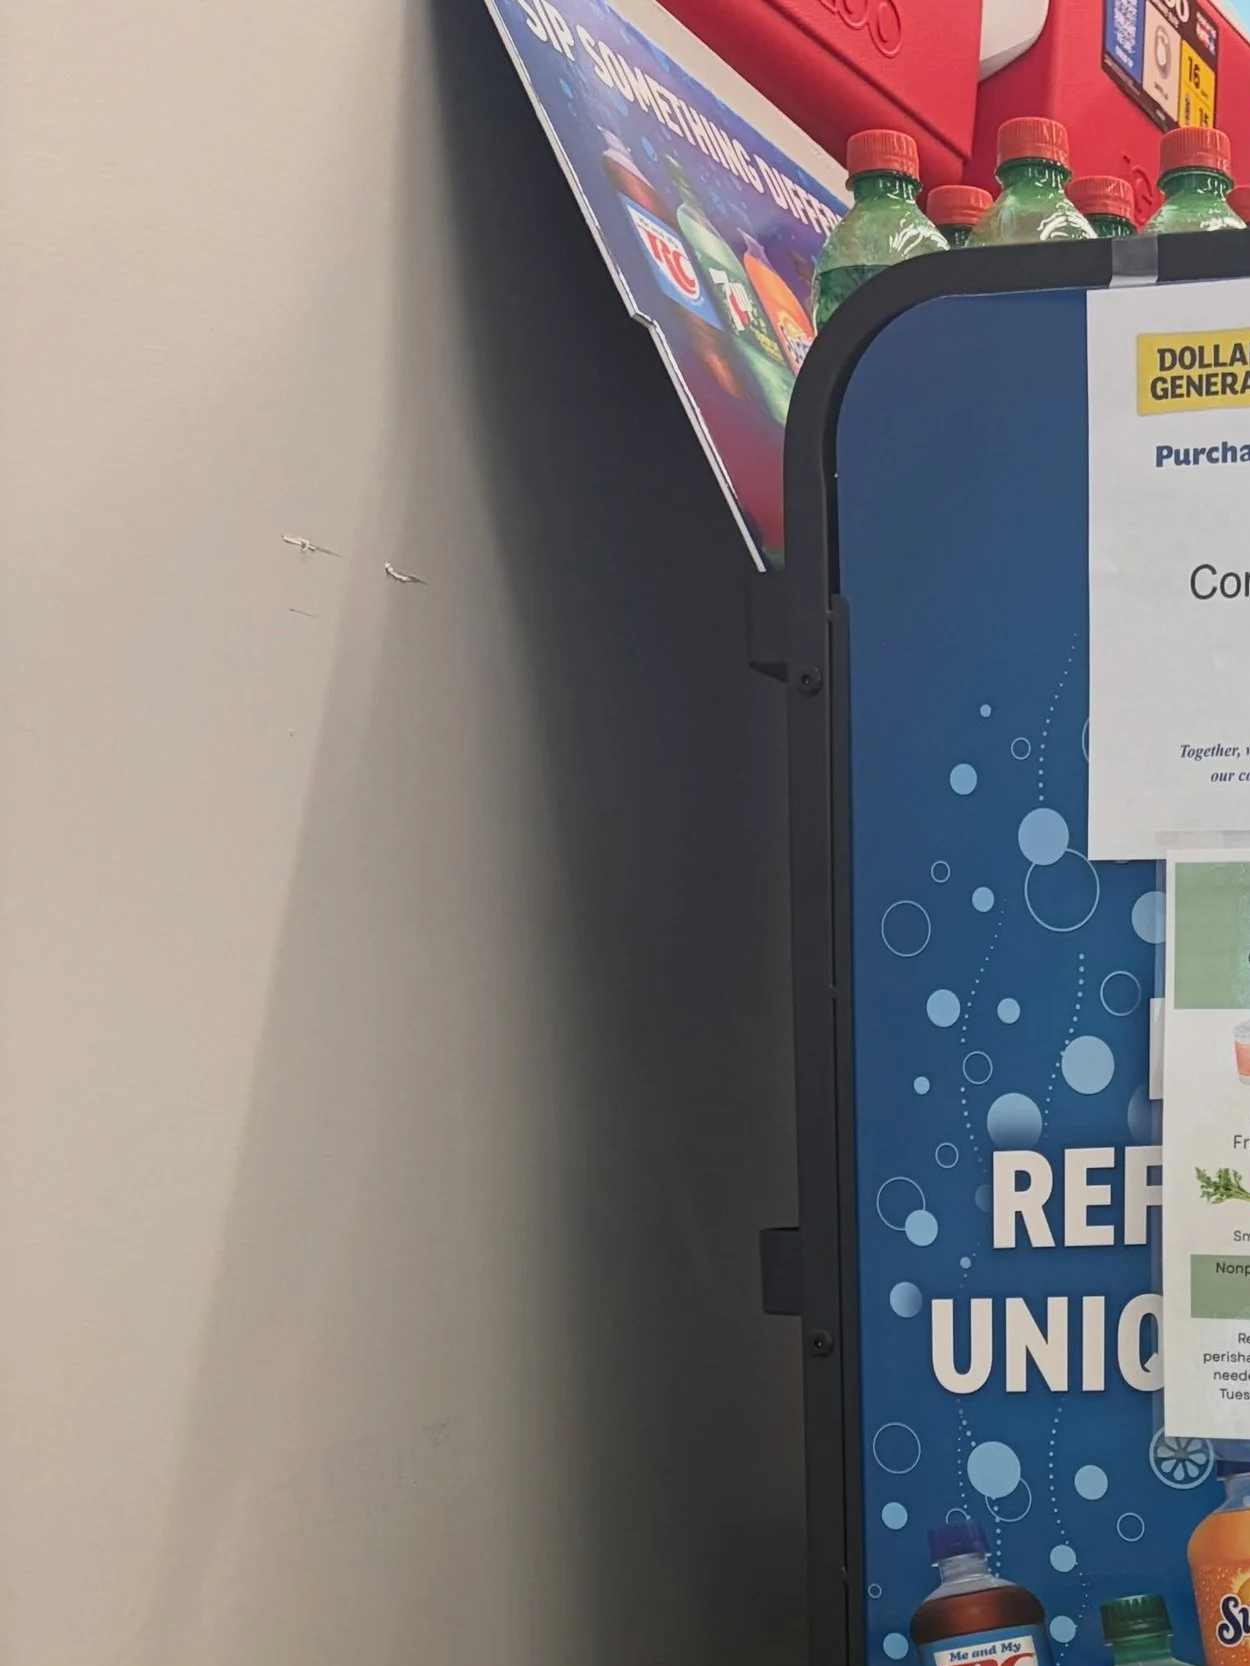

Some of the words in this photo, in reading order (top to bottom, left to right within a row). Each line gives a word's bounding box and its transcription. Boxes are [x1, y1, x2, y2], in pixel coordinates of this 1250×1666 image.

[515, 0, 575, 62] SIP
[576, 24, 766, 194] SOMETHING
[641, 230, 702, 295] RC
[1180, 743, 1241, 761] Together,
[1210, 770, 1235, 782] our
[949, 1651, 969, 1664] Me
[971, 1645, 997, 1659] and
[1001, 1641, 1021, 1656] My
